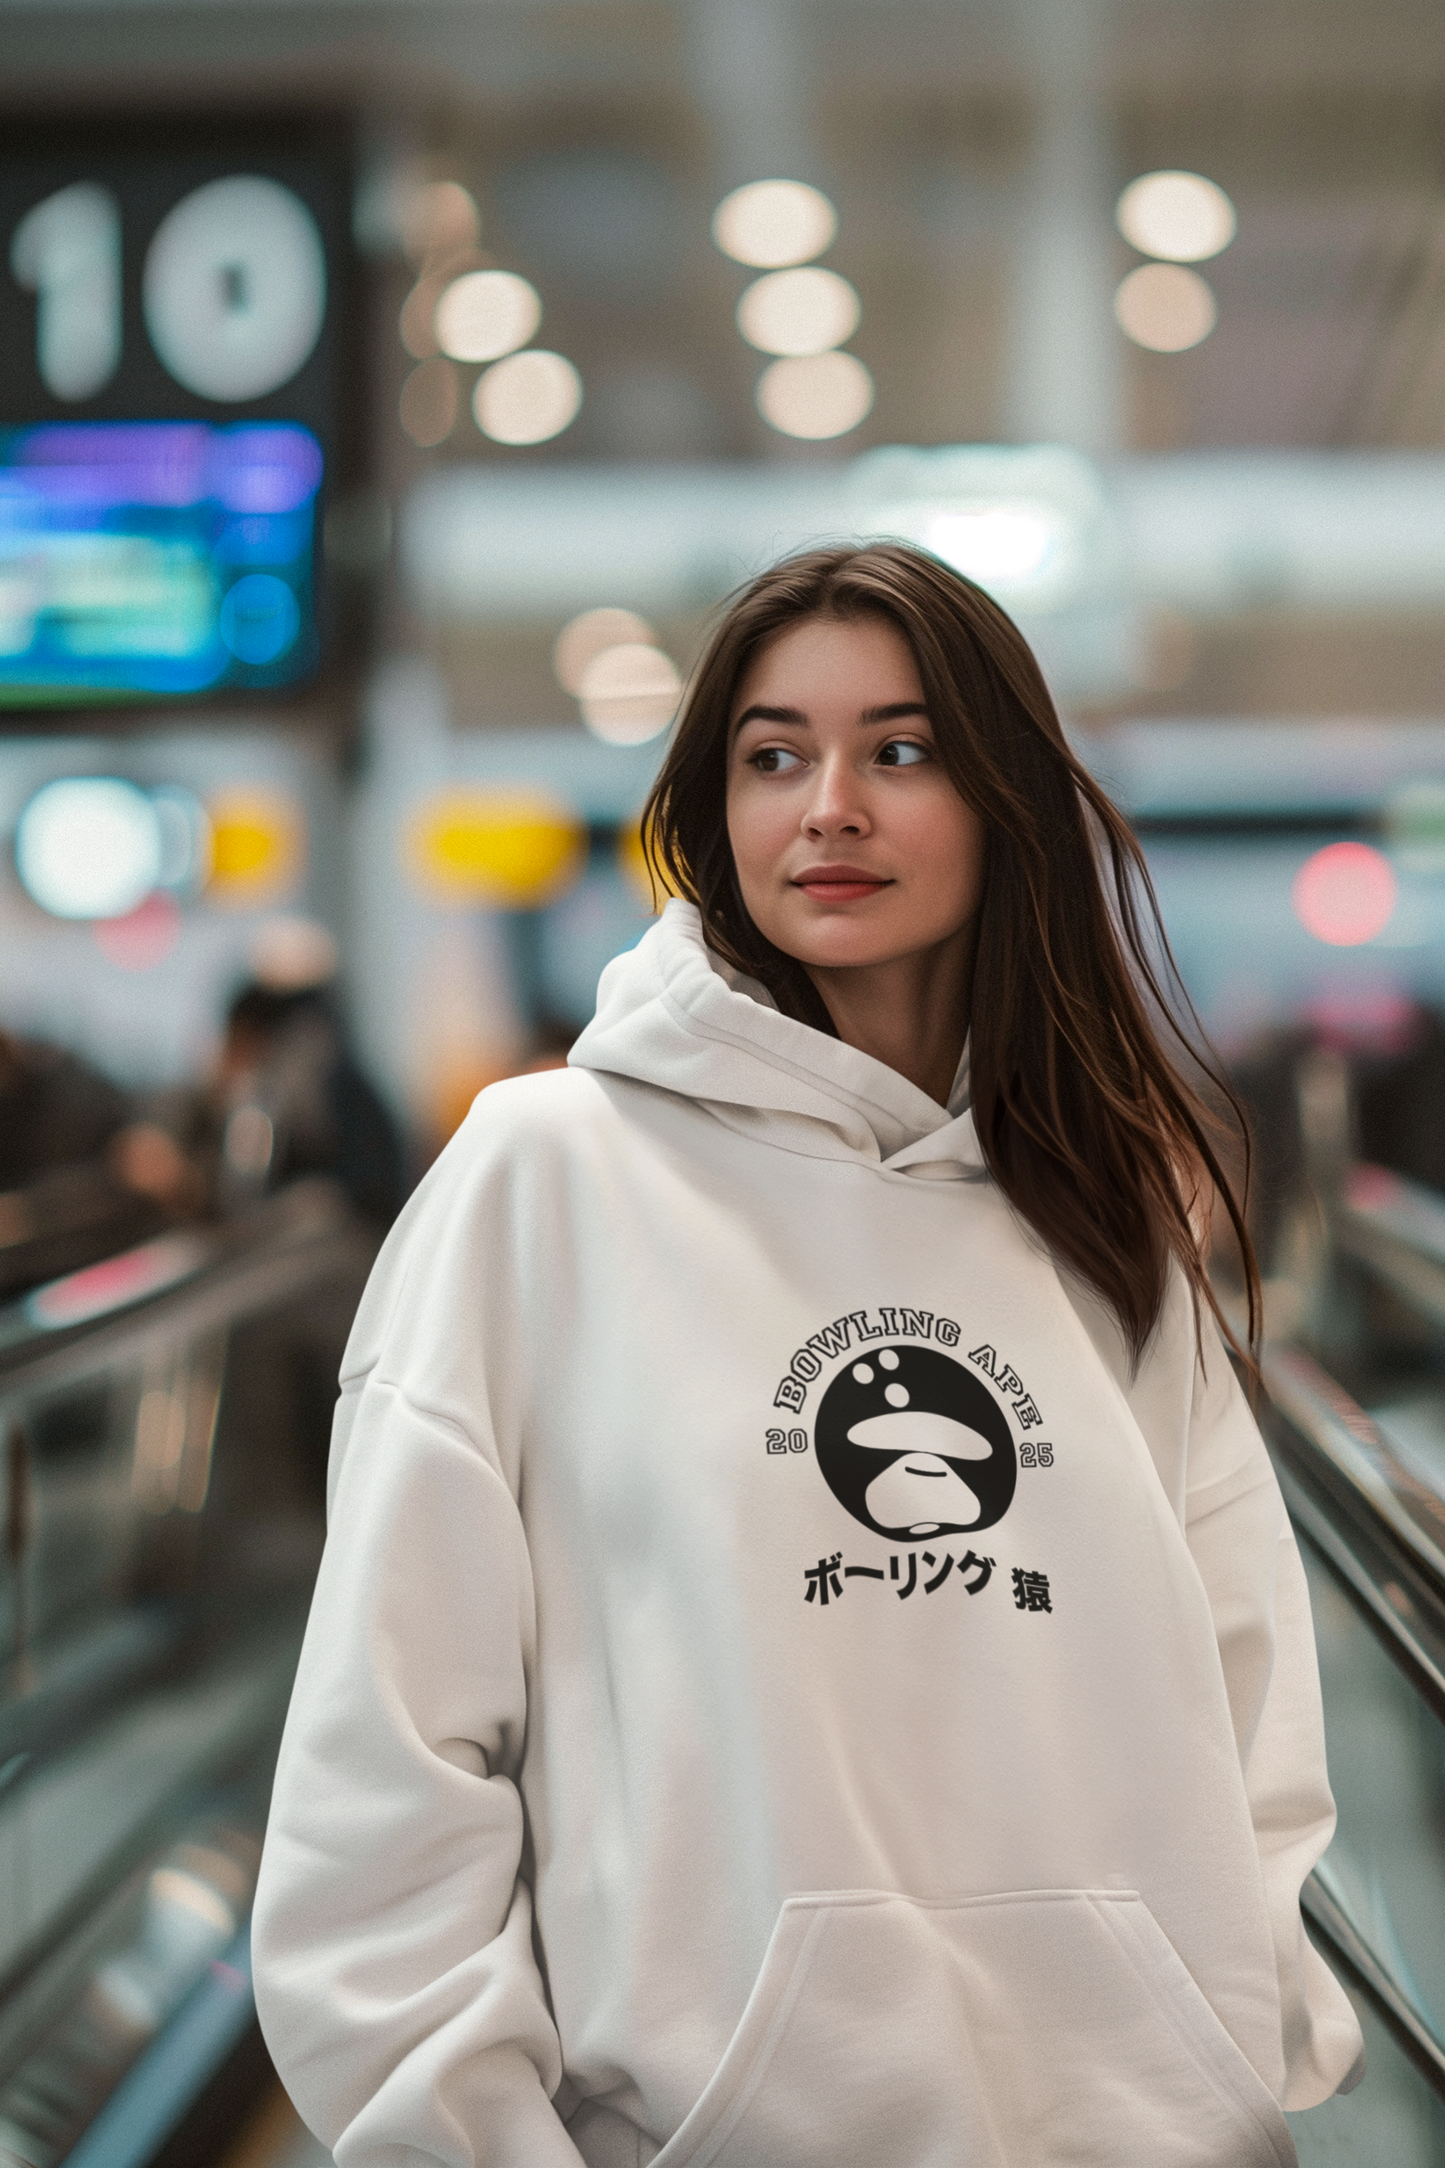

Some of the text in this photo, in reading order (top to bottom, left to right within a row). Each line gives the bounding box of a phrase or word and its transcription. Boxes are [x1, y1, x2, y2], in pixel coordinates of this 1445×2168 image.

[12, 176, 326, 403] 10
[773, 1307, 1044, 1431] BOWLING APE
[765, 1428, 1055, 1469] 20 25
[803, 1549, 1053, 1614] ボーリング 猿
